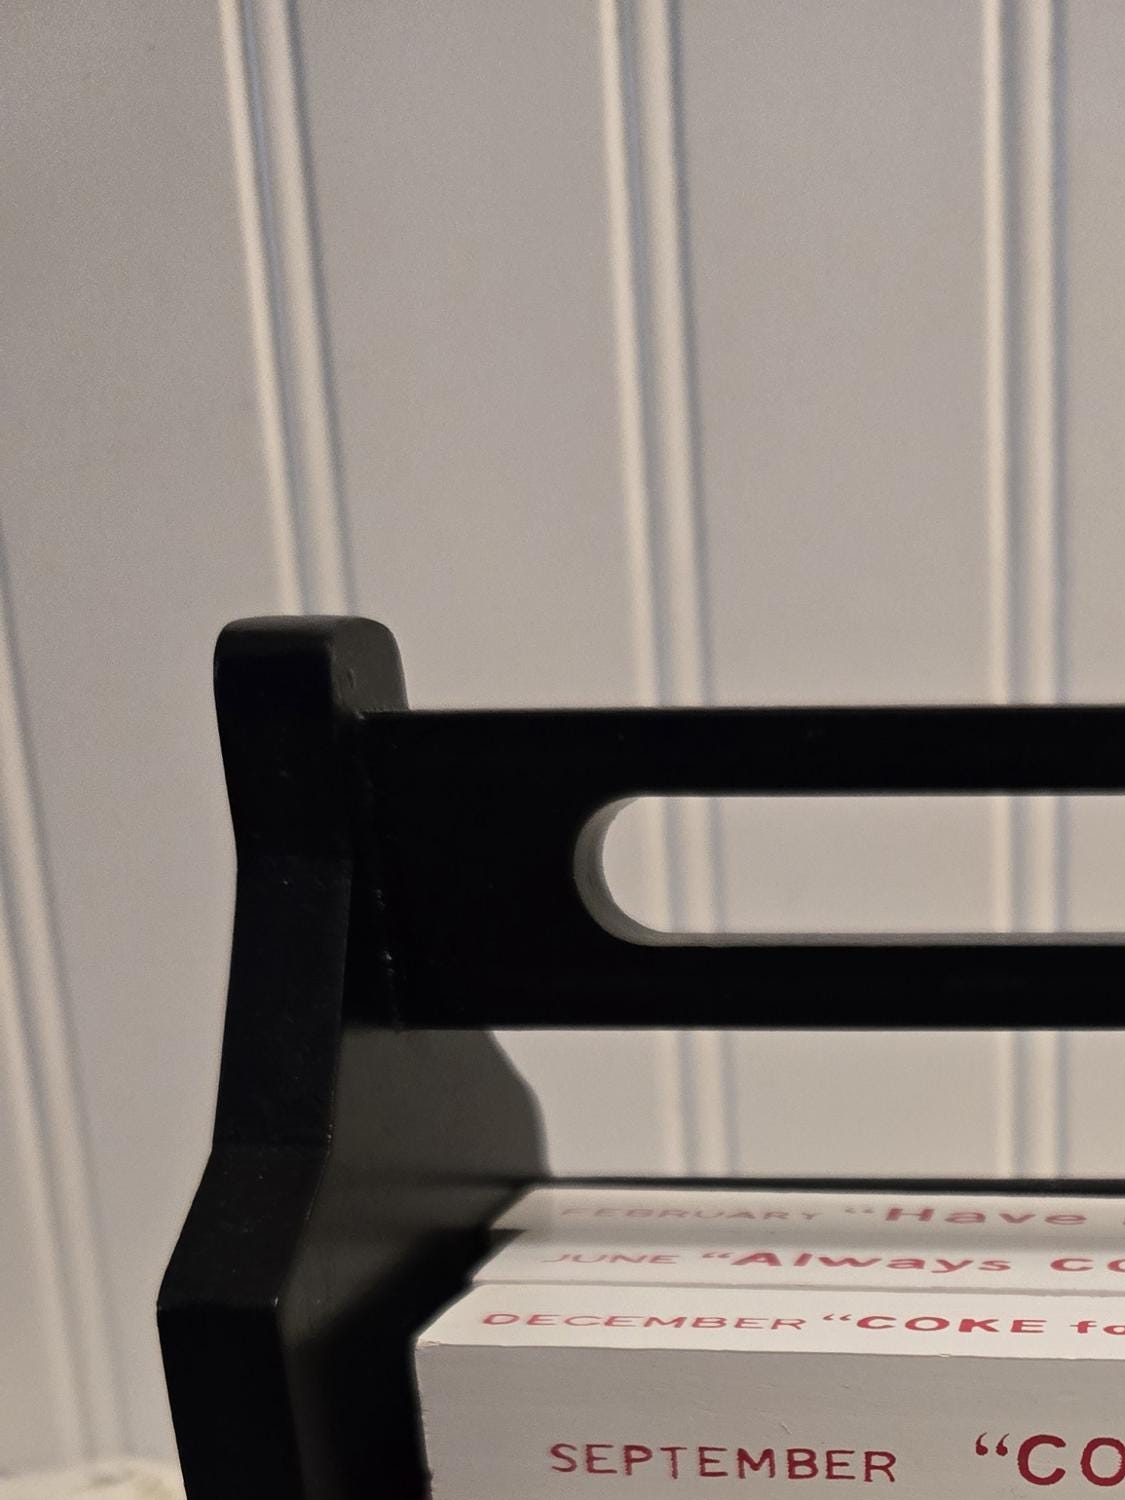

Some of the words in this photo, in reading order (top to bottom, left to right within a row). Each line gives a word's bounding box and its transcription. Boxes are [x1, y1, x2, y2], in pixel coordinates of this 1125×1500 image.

[560, 1206, 824, 1222] FEBRUARY
[540, 1253, 680, 1266] JUNE
[481, 1312, 808, 1332] DECEMBER
[549, 1442, 898, 1483] SEPTEMBER
